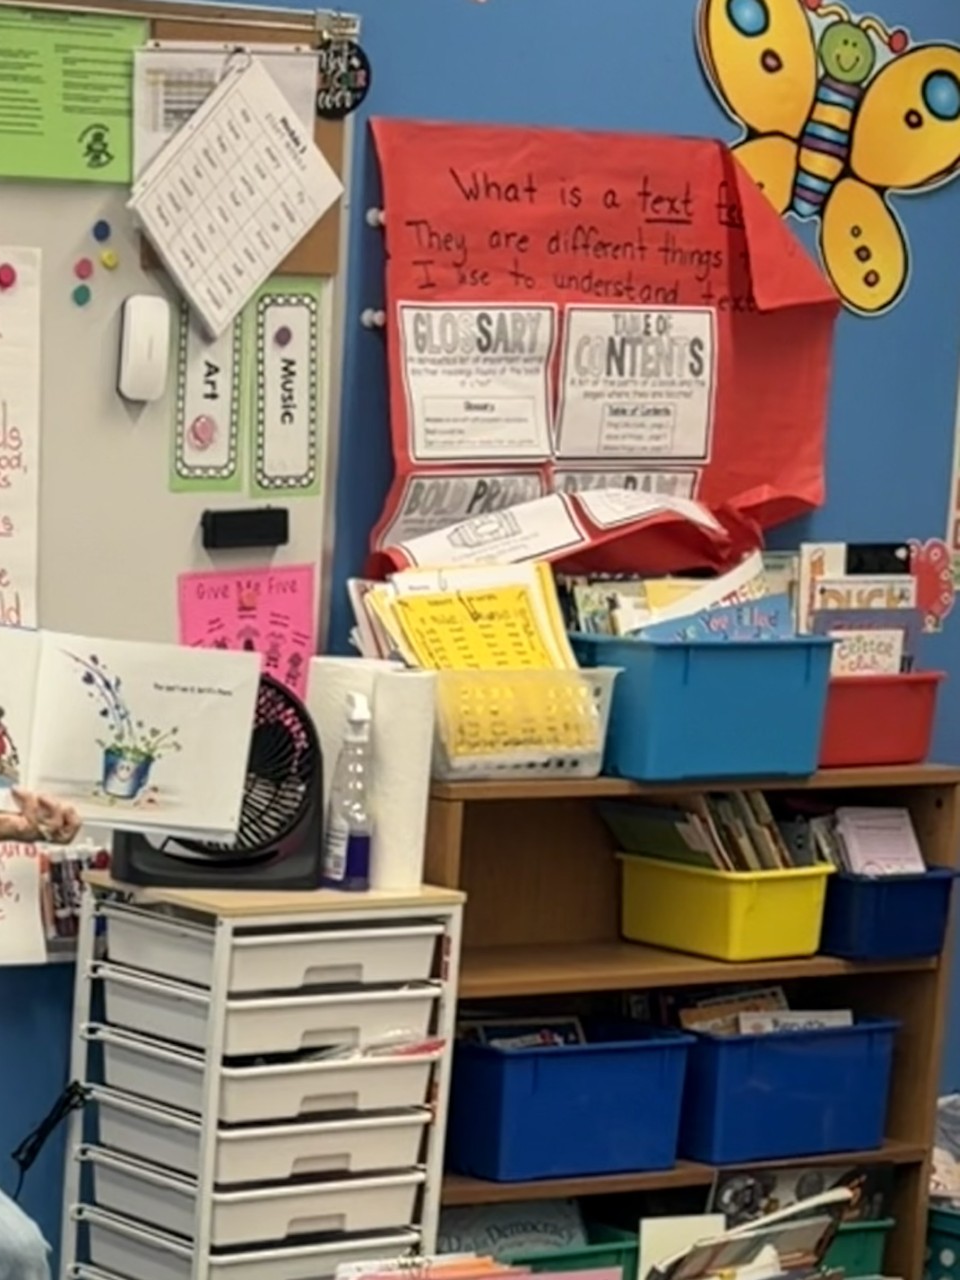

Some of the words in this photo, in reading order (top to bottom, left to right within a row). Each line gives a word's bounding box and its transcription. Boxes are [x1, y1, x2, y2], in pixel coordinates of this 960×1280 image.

[449, 168, 538, 203] What
[559, 178, 583, 208] is
[602, 187, 621, 209] a
[640, 176, 694, 216] text
[405, 219, 469, 267] They
[487, 228, 530, 256] are
[547, 226, 647, 260] different
[657, 230, 724, 282] things
[412, 258, 437, 290] I
[456, 262, 492, 288] use
[509, 260, 536, 290] to
[553, 271, 681, 305] understand
[413, 312, 543, 354] GLOSSARY
[575, 335, 704, 378] CONTENTS
[203, 359, 220, 401] Art
[279, 357, 297, 426] Music
[196, 582, 230, 600] Give
[268, 576, 297, 594] Five
